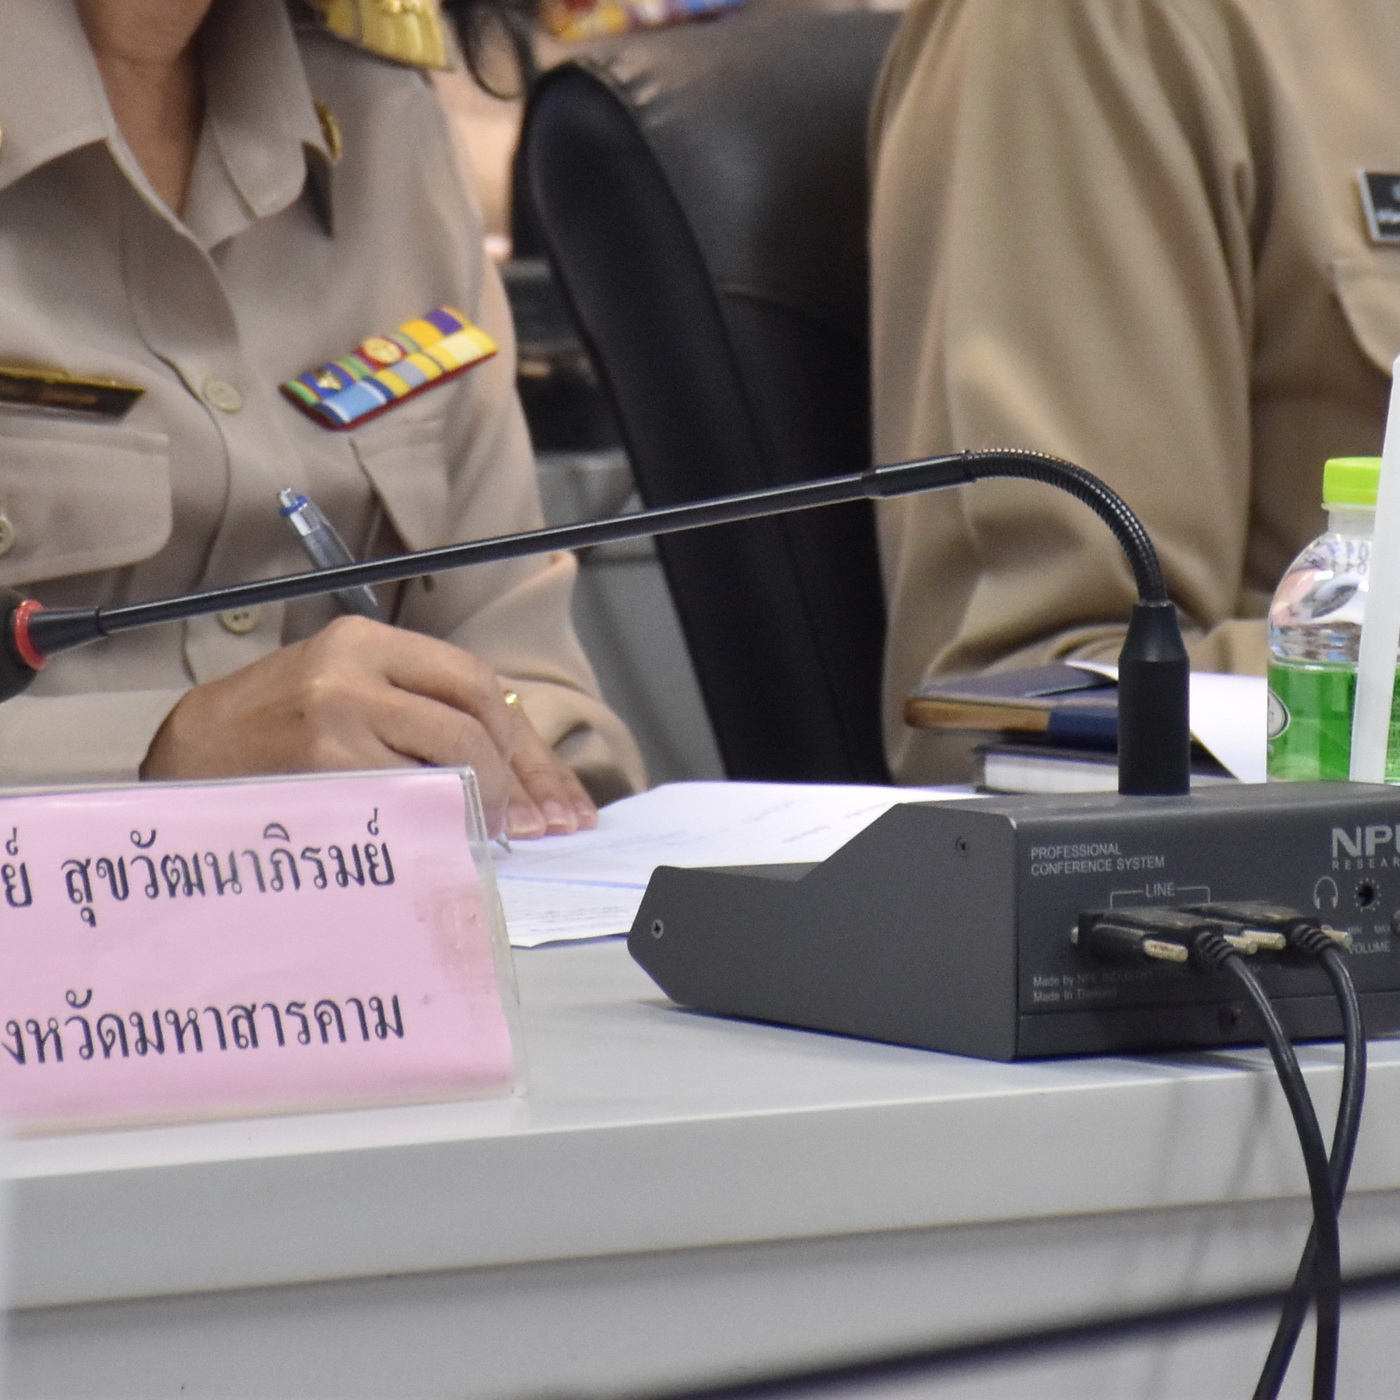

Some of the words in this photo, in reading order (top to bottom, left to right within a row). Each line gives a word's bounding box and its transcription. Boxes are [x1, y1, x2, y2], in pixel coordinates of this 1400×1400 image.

[1030, 842, 1122, 860] PROFESSIONAL
[60, 806, 396, 928] สุขวัฒนาภิรมย์
[1030, 858, 1112, 876] CONFERENCE
[1116, 855, 1165, 871] SYSTEM
[1145, 882, 1176, 898] LINE
[1348, 941, 1391, 955] VOLUME
